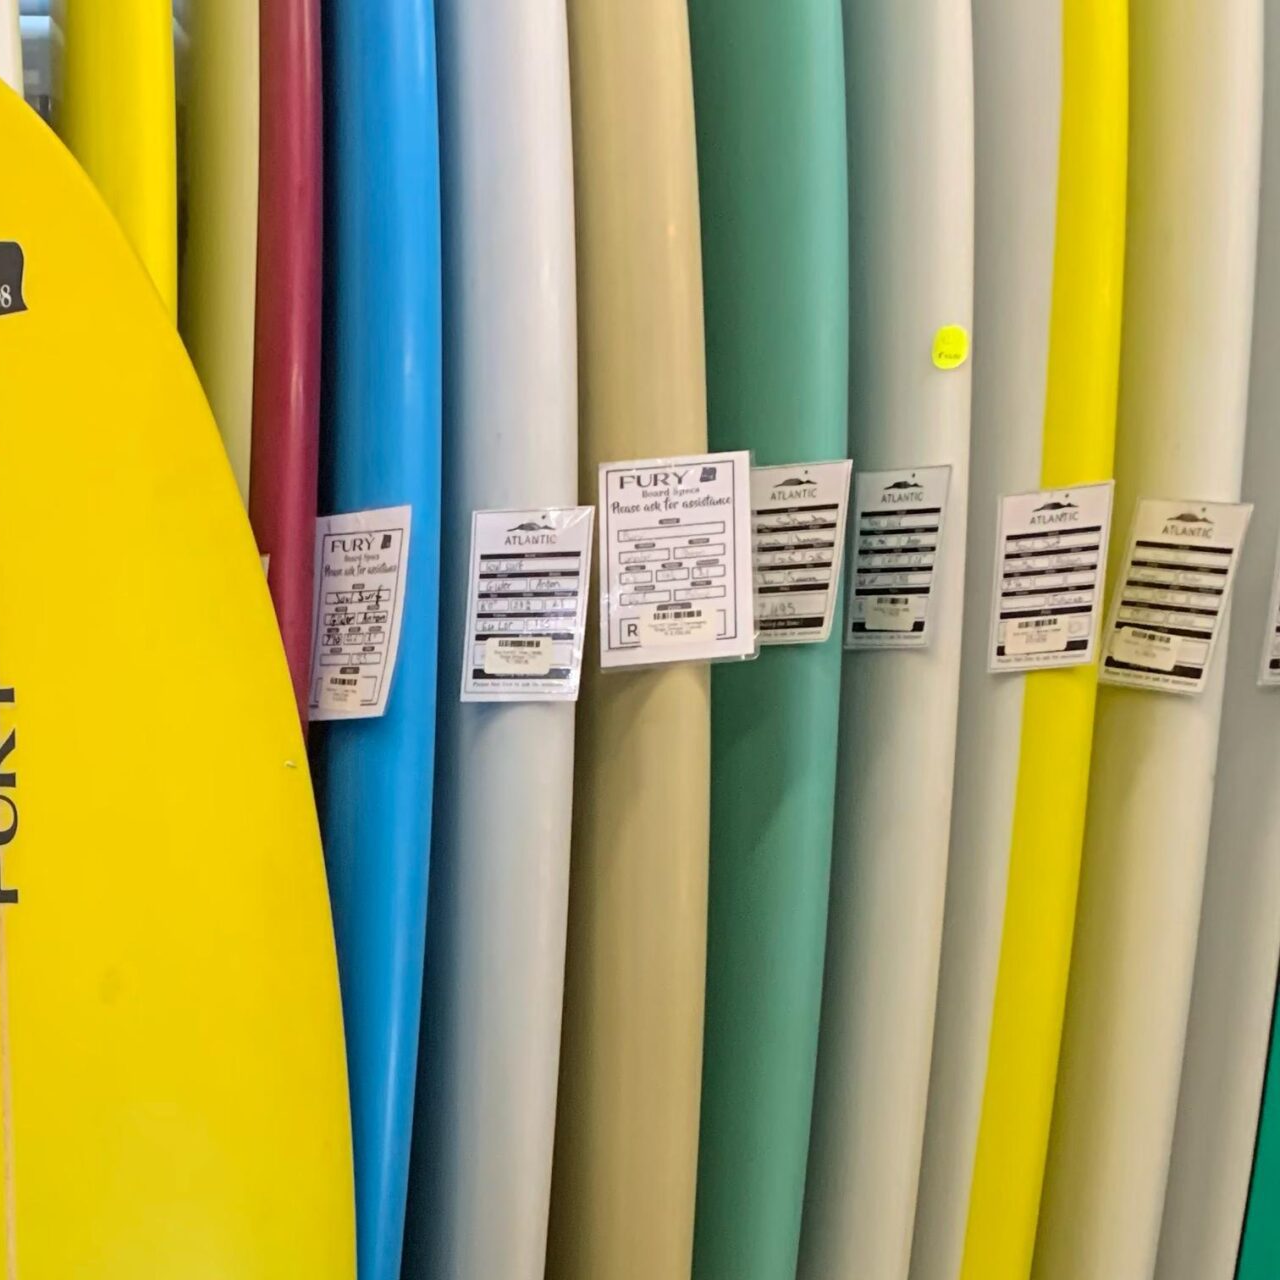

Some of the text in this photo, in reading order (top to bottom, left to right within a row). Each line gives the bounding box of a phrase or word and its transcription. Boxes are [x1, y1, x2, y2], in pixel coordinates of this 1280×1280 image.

[620, 470, 689, 489] FURY
[642, 488, 670, 498] Board
[771, 488, 817, 500] ATLANTIC
[881, 492, 923, 503] ATLANTIC
[611, 494, 731, 514] Please ask for assistance
[1030, 511, 1078, 525] ATLANTIC
[1162, 525, 1214, 539] ATLANTIC
[331, 537, 375, 552] FURY
[505, 534, 557, 545] ATLANTIC
